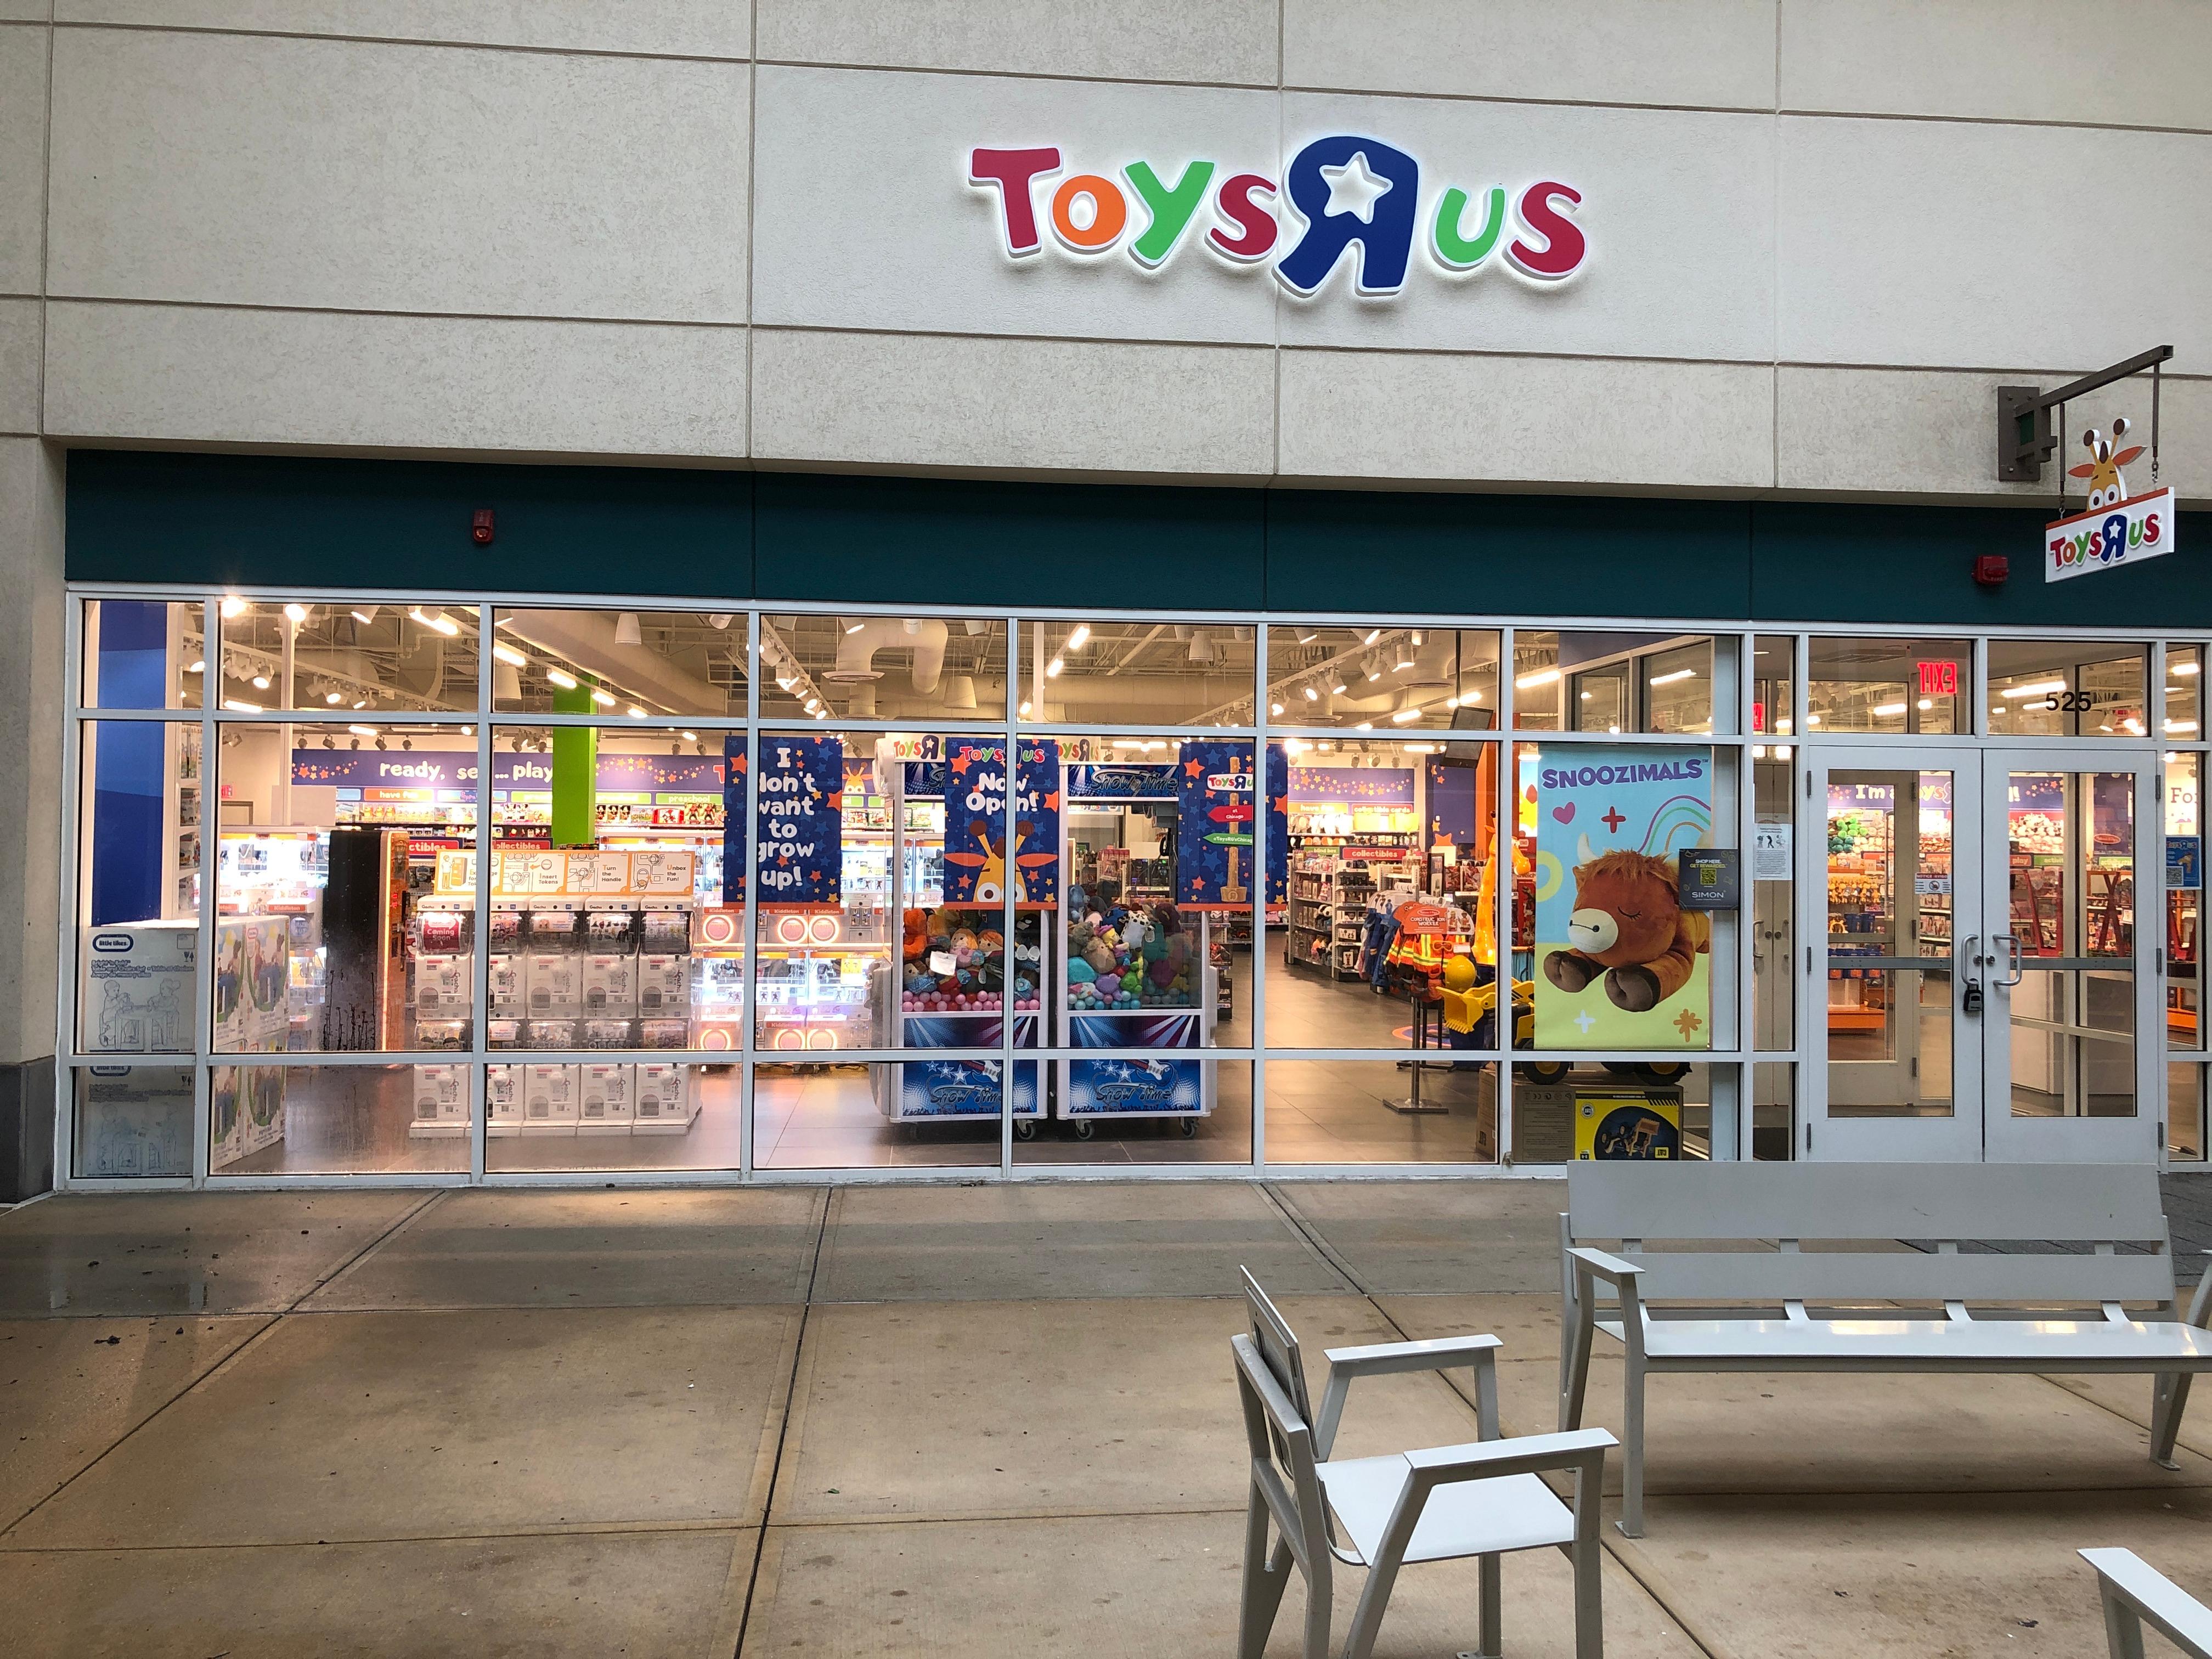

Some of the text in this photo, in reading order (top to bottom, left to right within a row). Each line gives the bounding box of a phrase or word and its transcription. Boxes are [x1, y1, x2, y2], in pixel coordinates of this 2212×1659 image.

[2045, 691, 2092, 712] 525
[777, 747, 791, 768] I
[380, 761, 445, 782] ready,
[513, 761, 552, 783] play
[1542, 759, 1703, 789] SNOOZIMALS
[668, 795, 710, 804] preschool
[1855, 785, 1886, 799] I'm
[769, 819, 797, 838] to
[1213, 836, 1253, 844] @ToysRUsChicag
[2012, 856, 2028, 865] play
[761, 866, 803, 891] up!
